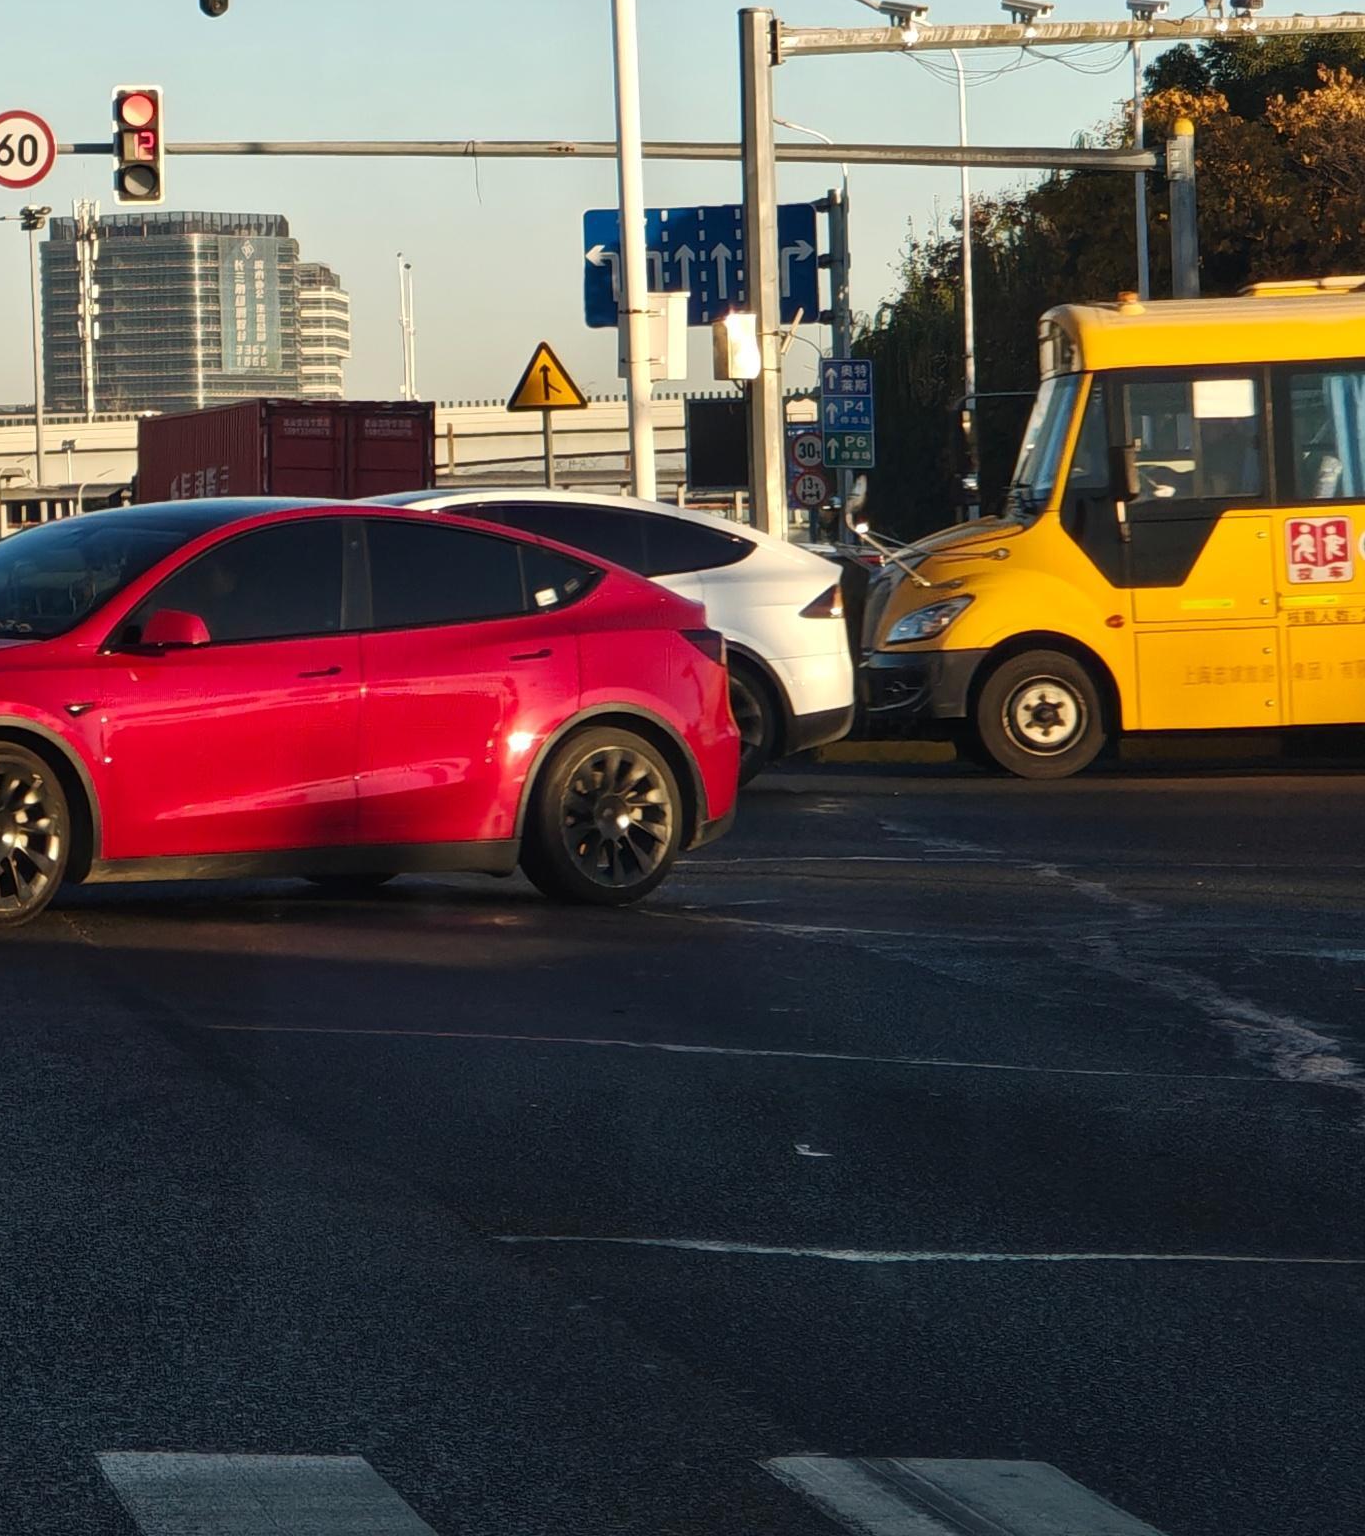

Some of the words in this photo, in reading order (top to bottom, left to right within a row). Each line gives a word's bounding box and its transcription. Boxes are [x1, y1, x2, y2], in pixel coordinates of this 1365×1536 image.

[133, 131, 155, 161] 12
[840, 364, 868, 378] 奥特
[840, 379, 868, 393] 莱斯
[843, 400, 865, 413] P4
[844, 435, 867, 448] P6
